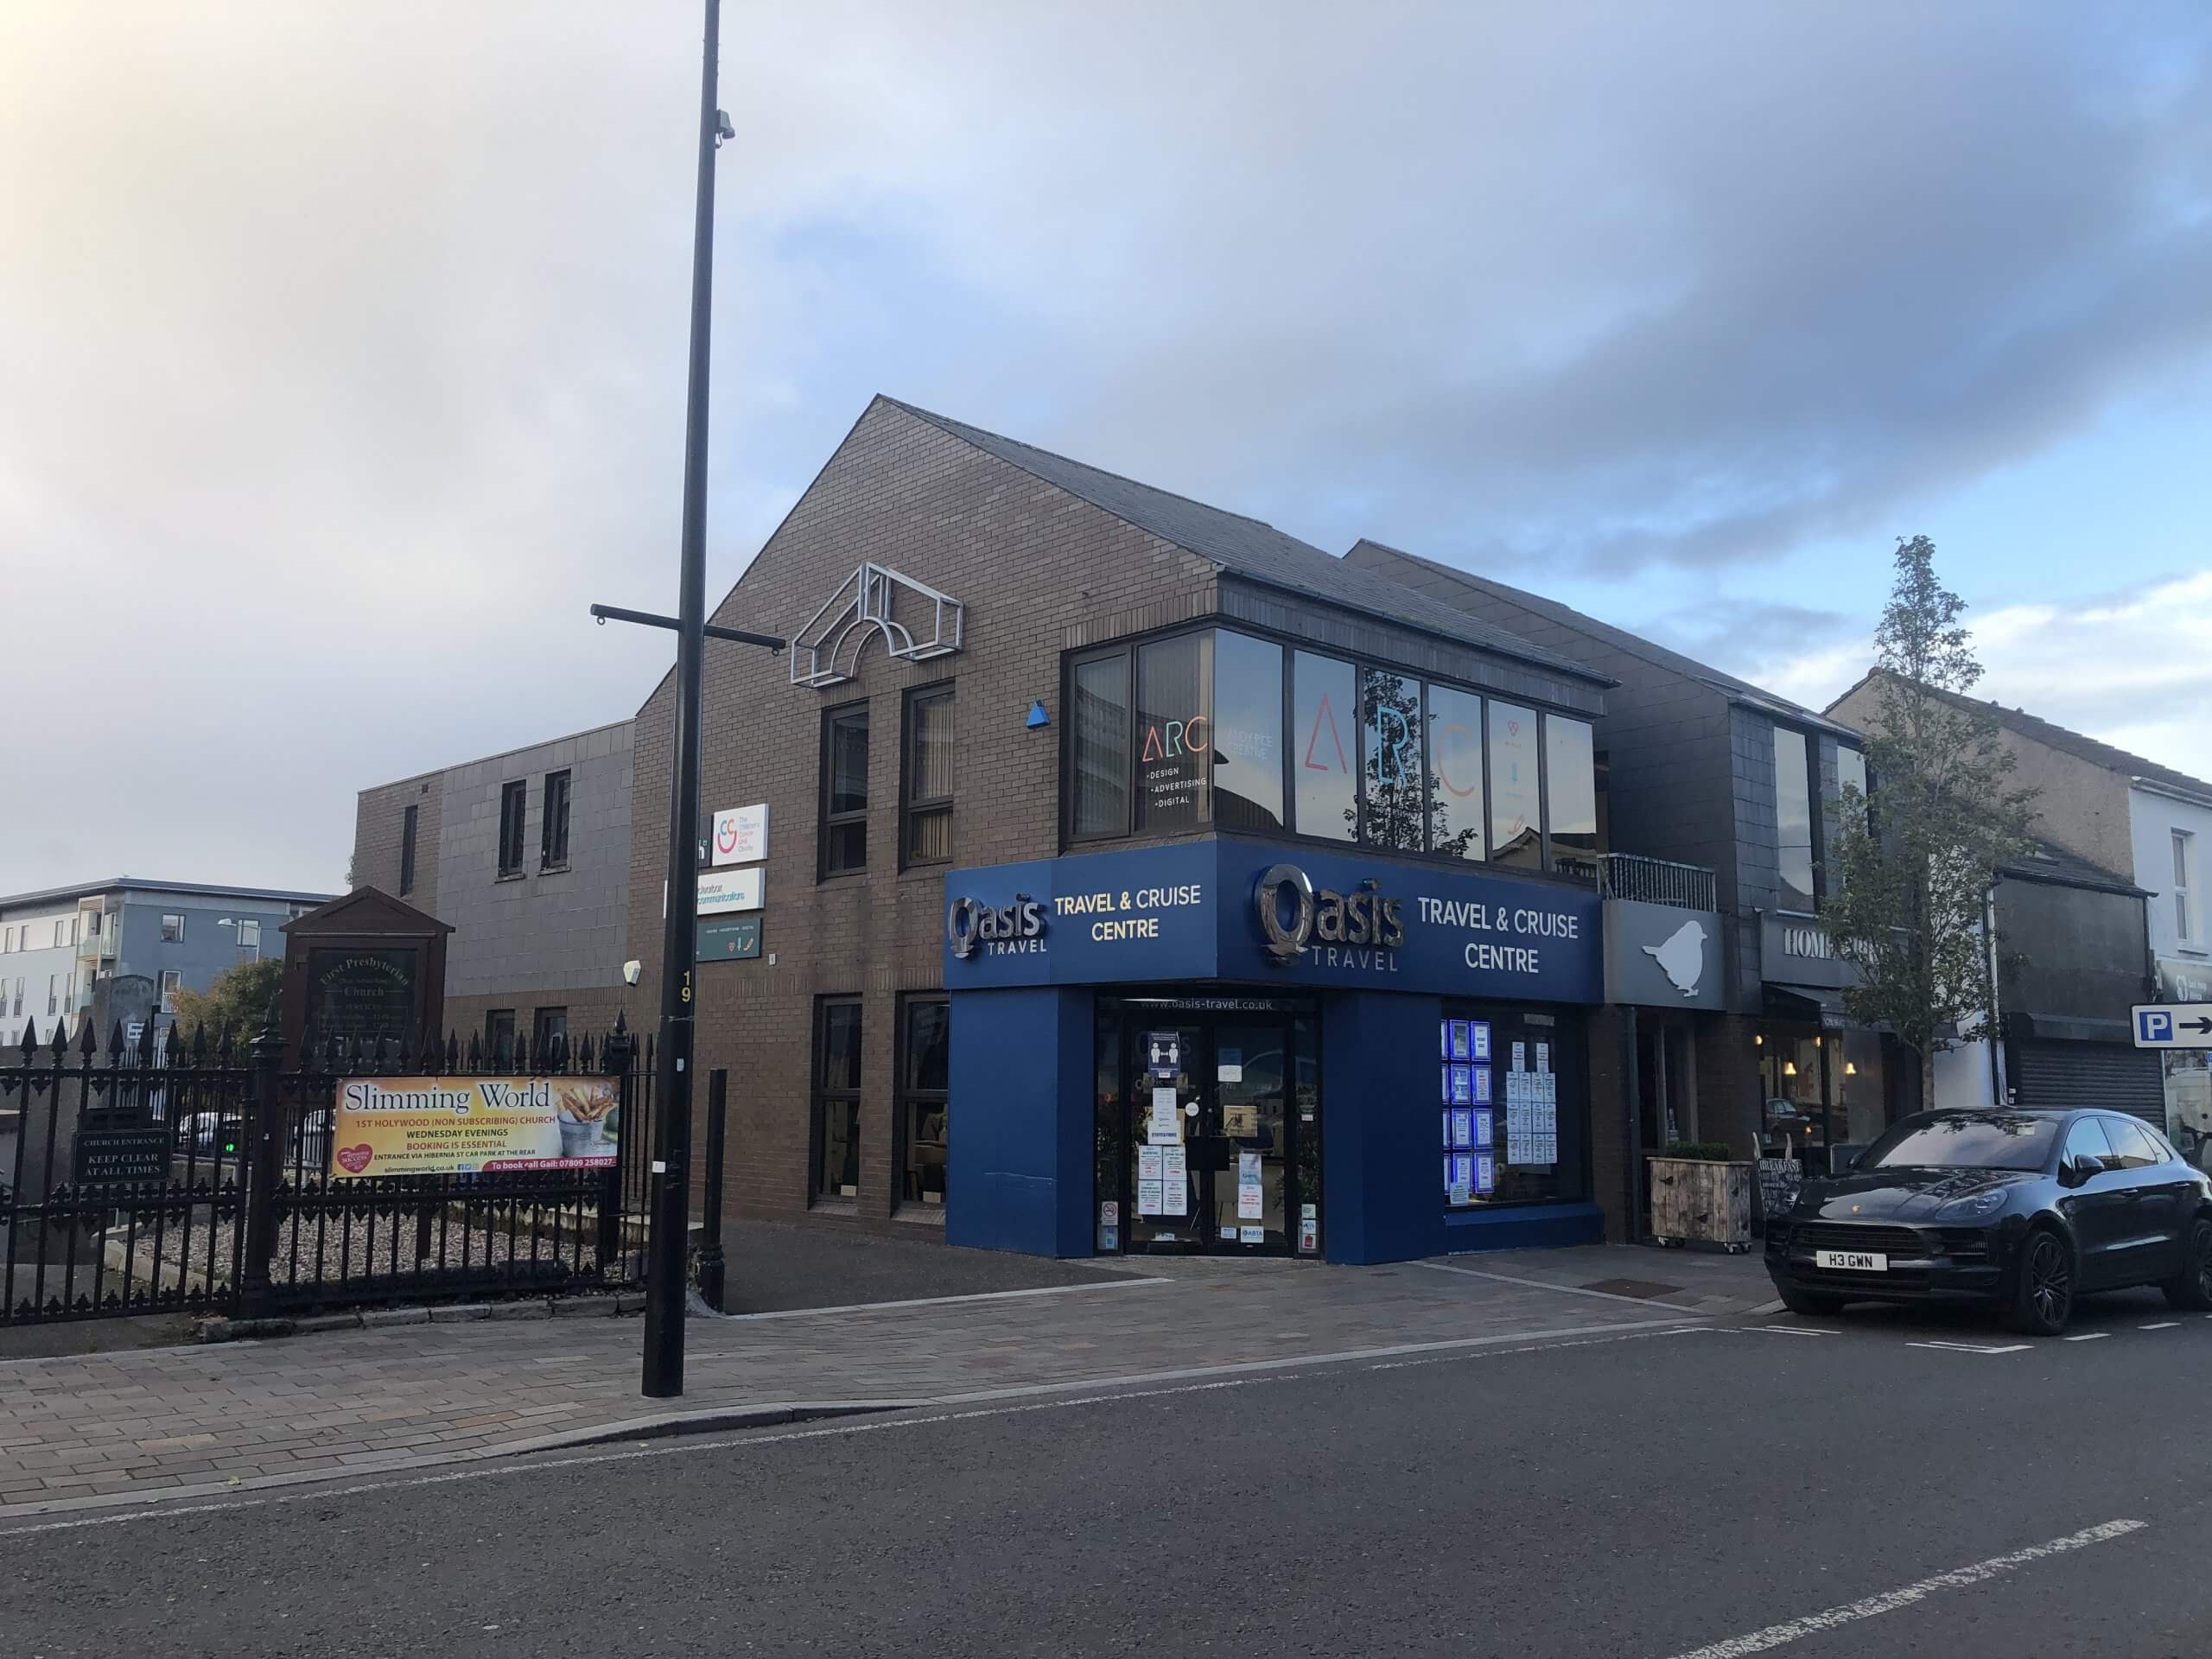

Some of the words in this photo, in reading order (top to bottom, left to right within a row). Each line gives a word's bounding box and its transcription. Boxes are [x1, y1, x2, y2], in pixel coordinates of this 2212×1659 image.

[1142, 715, 1208, 762] ARC
[1150, 767, 1179, 779] DESIGN
[1154, 778, 1207, 793] ADVERTISING
[1158, 796, 1190, 808] DIGITAL
[1054, 893, 1116, 916] TRAVEL
[1120, 891, 1132, 910] &
[1135, 885, 1201, 909] CRUISE
[1257, 863, 1405, 967] Oasis
[1417, 897, 1491, 931] TRAVEL
[1496, 907, 1510, 932] &
[1514, 908, 1579, 939] CRUISE
[949, 893, 1045, 960] Oasis
[1091, 918, 1159, 942] CENTRE
[988, 938, 1047, 957] TRAVEL
[1312, 944, 1399, 972] TRAVEL
[1465, 943, 1539, 974] CENTRE
[344, 987, 385, 996] Church
[2146, 1014, 2168, 1039] P
[346, 1081, 470, 1115] Slimming
[479, 1079, 550, 1109] World
[356, 1119, 373, 1128] 1ST
[375, 1118, 429, 1128] HOLYWOOD
[432, 1117, 456, 1127] (NON
[458, 1116, 518, 1126] SUBSCRIBING)
[520, 1116, 556, 1124] CHURCH
[406, 1130, 462, 1139] WEDNESDAY
[465, 1128, 508, 1137] EVENINGS
[84, 1138, 120, 1147] CHURCH
[122, 1136, 165, 1146] ENTRANCE
[406, 1141, 449, 1151] BOOKING
[461, 1140, 507, 1149] ESSENTIAL
[88, 1154, 119, 1164] KEEP
[121, 1154, 159, 1163] CLEAR
[492, 1161, 501, 1170] To
[503, 1160, 524, 1169] book
[525, 1160, 538, 1168] call
[539, 1159, 557, 1168] Gail:
[559, 1159, 583, 1167] 07809
[585, 1158, 613, 1166] 258027
[85, 1167, 99, 1177] AT
[101, 1166, 124, 1176] ALL
[125, 1165, 162, 1175] TIMES
[385, 1164, 454, 1174] slimmingworld.co.uk
[1829, 1254, 1845, 1266] H3
[1847, 1255, 1873, 1268] GWN
